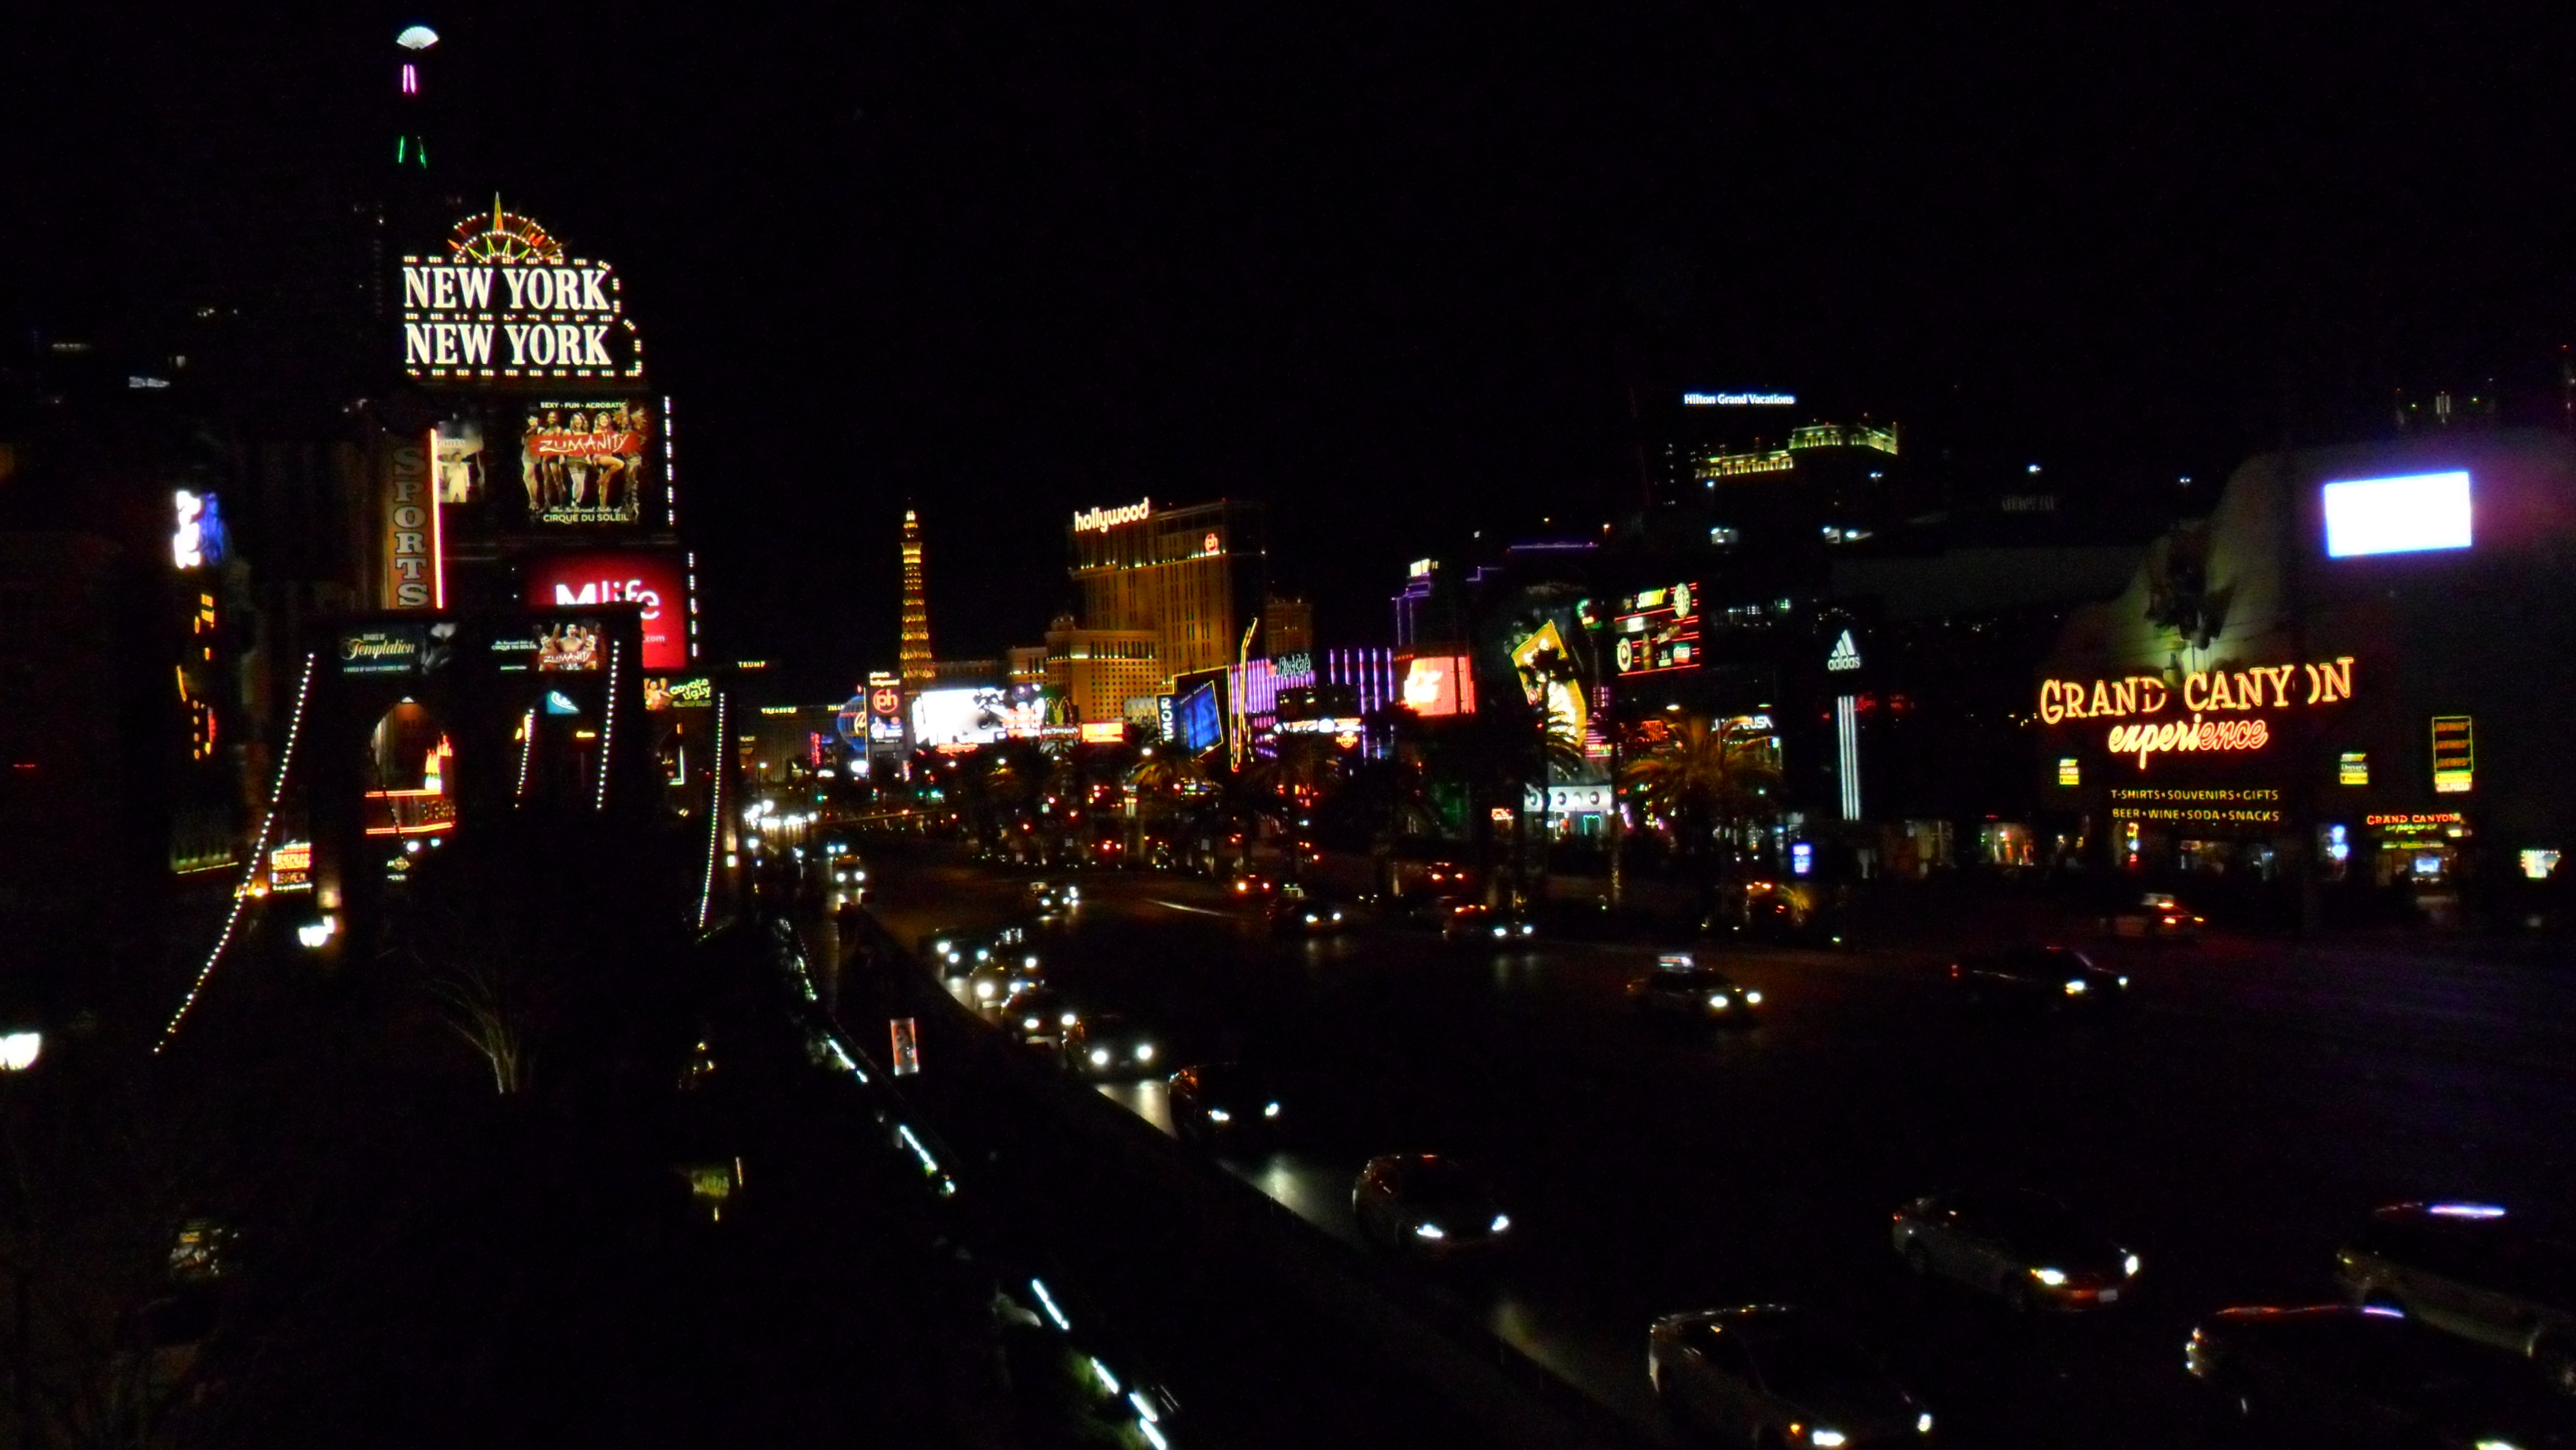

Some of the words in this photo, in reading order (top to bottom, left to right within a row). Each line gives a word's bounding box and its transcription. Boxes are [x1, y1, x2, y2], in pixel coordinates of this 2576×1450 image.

[403, 267, 493, 308] NEW
[503, 268, 610, 310] YORK
[404, 323, 494, 364] NEW
[504, 325, 611, 365] YORK
[586, 402, 626, 410] ACROBATIC
[1684, 393, 1716, 404] Hilton
[1717, 394, 1748, 405] Grand
[1748, 394, 1795, 404] Vacations
[539, 431, 629, 453] ZUMANITY
[543, 514, 579, 524] CIRQUE
[1075, 498, 1150, 533] hollywood
[395, 447, 429, 608] SPORTS
[1636, 587, 1667, 609] SUBWAY
[342, 638, 414, 660] Temptation
[1827, 654, 1861, 671] adidas
[669, 678, 709, 695] coyote
[683, 687, 711, 700] ugly
[876, 690, 898, 709] ph
[2040, 678, 2167, 724] GRAND
[2108, 713, 2268, 770] experience
[2110, 789, 2160, 800] T-SHIRTS
[2167, 789, 2235, 800] SOUVENIRS
[2242, 789, 2279, 800] GIFTS
[2112, 808, 2140, 818] BEER
[2148, 809, 2180, 820] WINE
[2186, 810, 2220, 820] SODA
[2227, 811, 2280, 822] SNACKS
[2367, 814, 2408, 825] GRAND
[2412, 813, 2457, 823] CANYON
